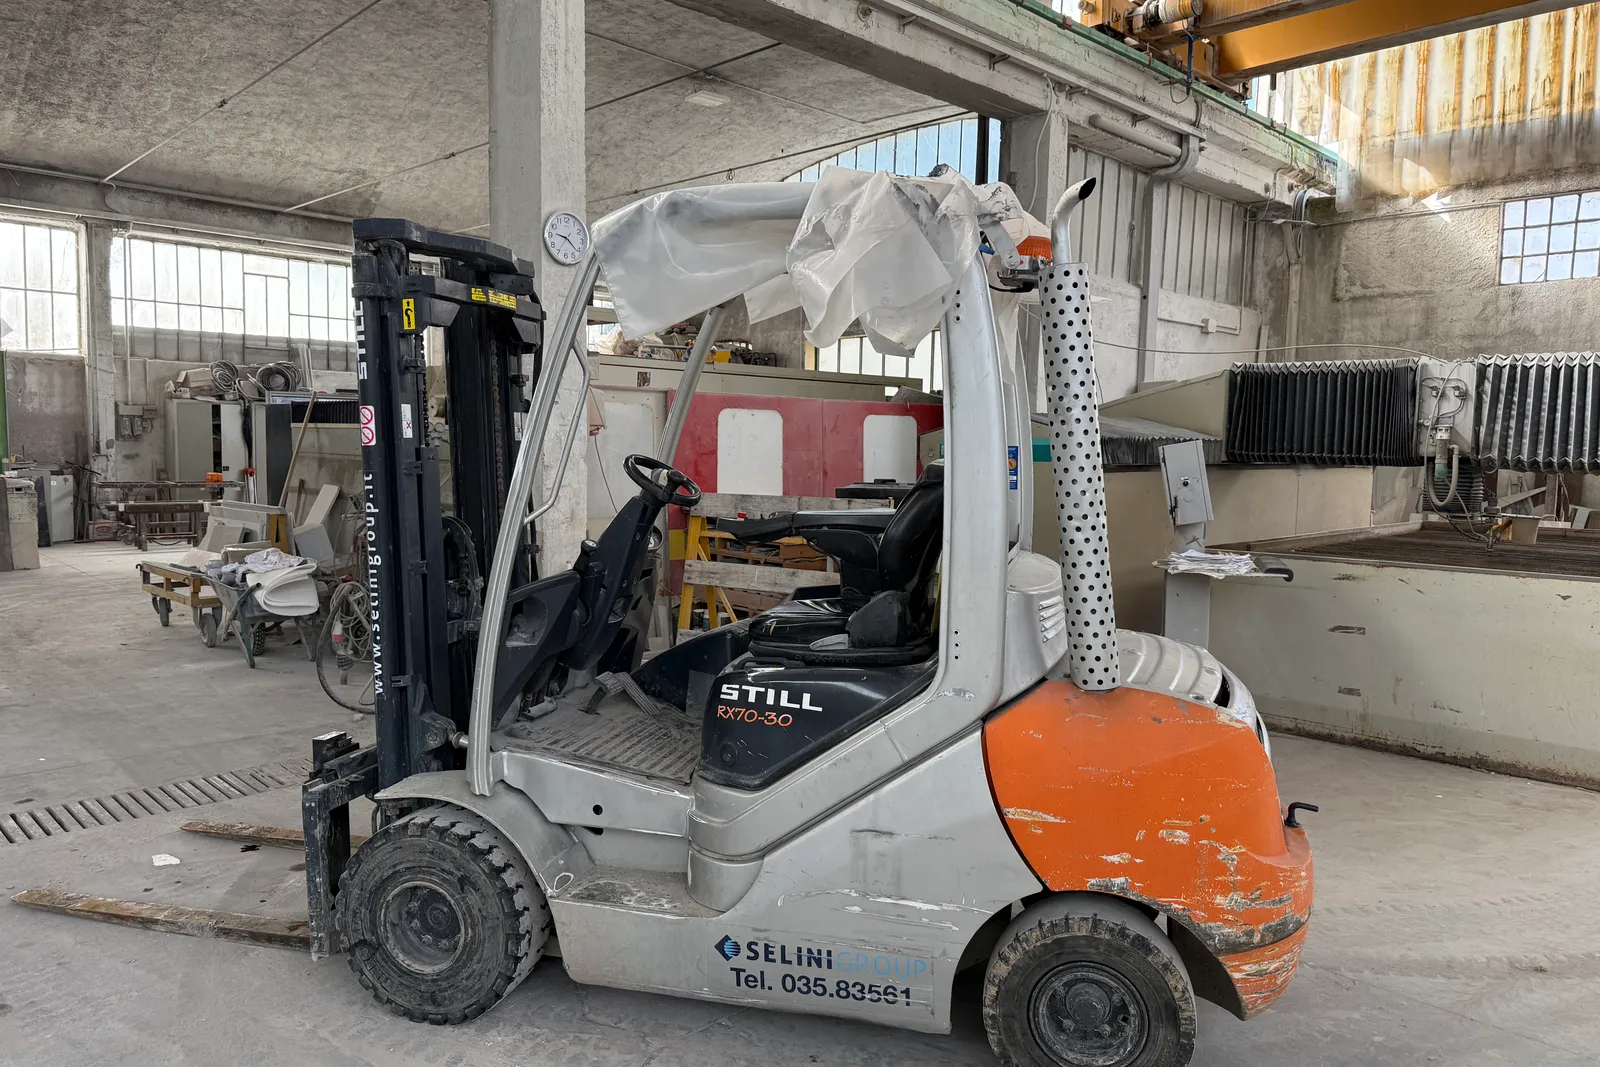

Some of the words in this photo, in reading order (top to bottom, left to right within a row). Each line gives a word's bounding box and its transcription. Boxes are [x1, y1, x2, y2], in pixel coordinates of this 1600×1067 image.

[355, 301, 368, 380] STILL
[720, 683, 823, 712] STILL
[717, 705, 793, 727] RX70-30
[729, 967, 773, 991] Tel.
[781, 973, 911, 1006] 035.83561
